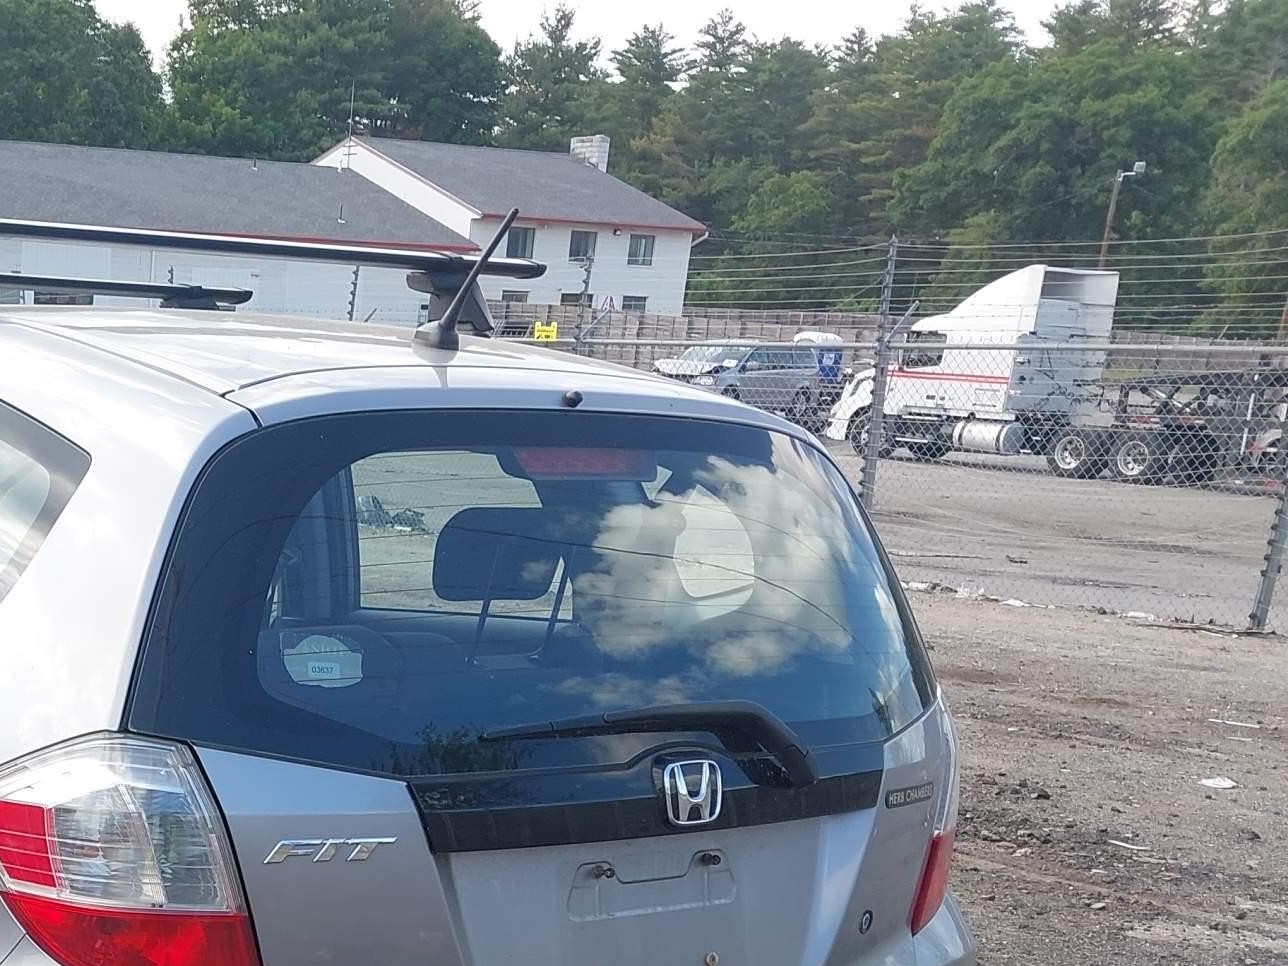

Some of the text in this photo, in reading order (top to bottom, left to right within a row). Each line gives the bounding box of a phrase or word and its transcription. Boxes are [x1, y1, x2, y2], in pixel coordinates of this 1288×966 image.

[889, 784, 933, 805] HERB CHAMBERS
[263, 836, 398, 864] FIT
